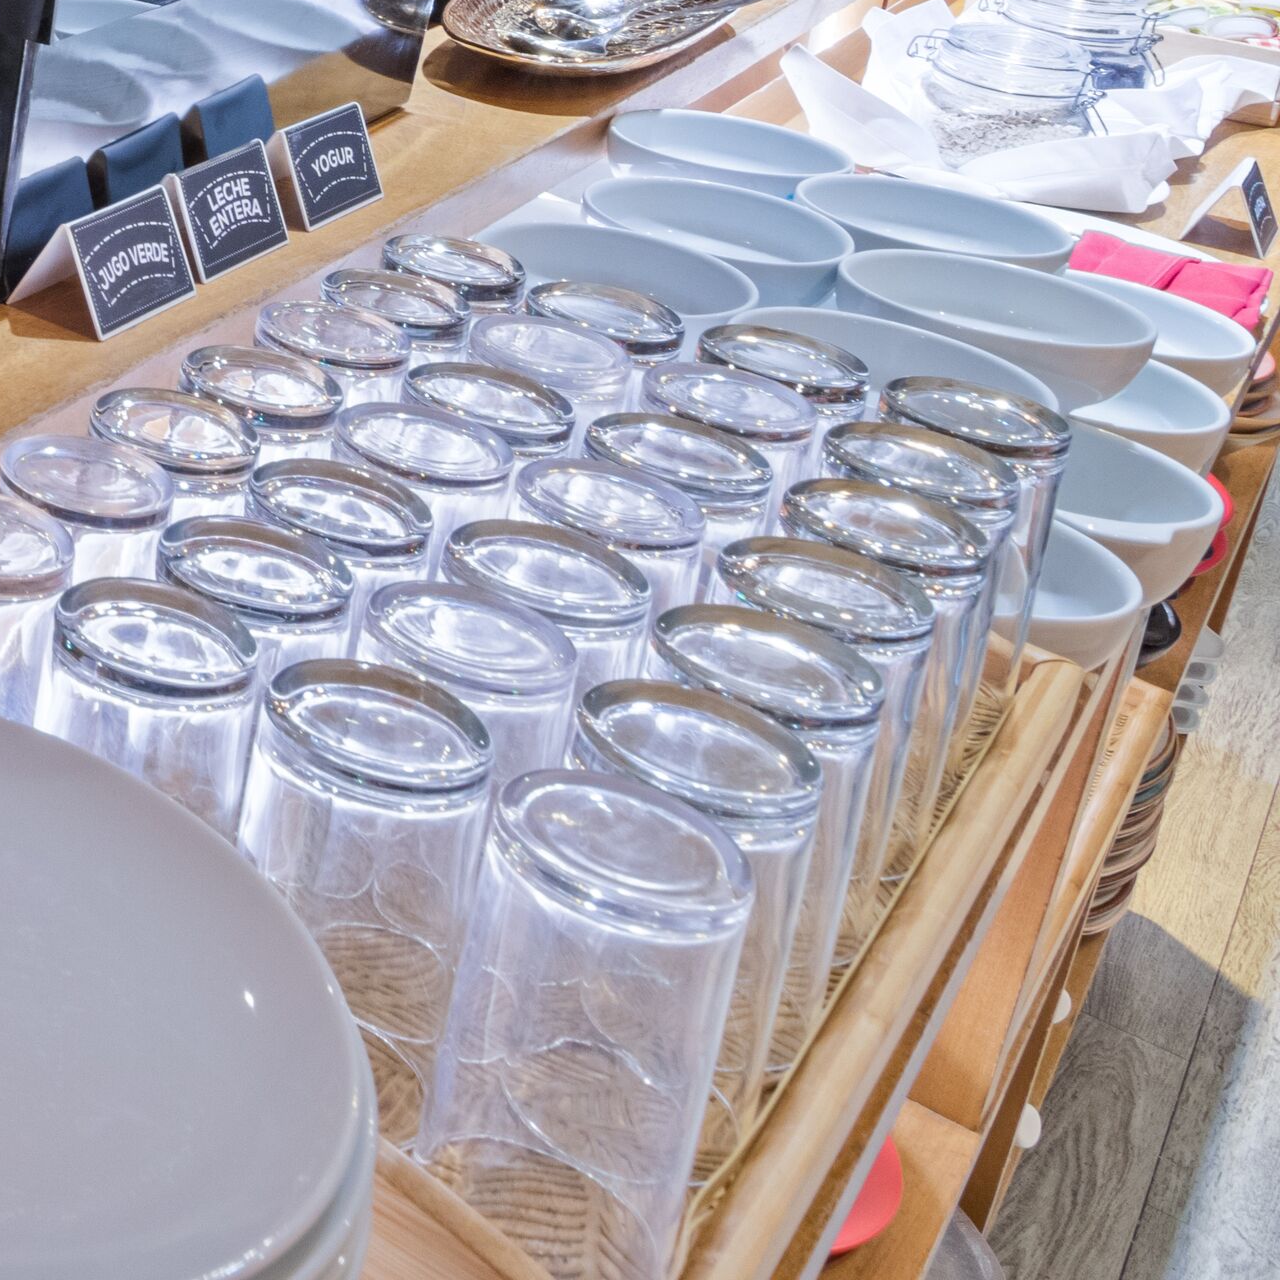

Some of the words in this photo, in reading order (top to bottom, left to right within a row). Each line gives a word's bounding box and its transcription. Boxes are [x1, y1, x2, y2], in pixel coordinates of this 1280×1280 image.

[311, 146, 356, 178] YOGUR
[206, 177, 252, 212] LECHE
[208, 198, 263, 236] ENTERA
[98, 254, 130, 290] JUGO
[128, 242, 170, 266] VERDE
